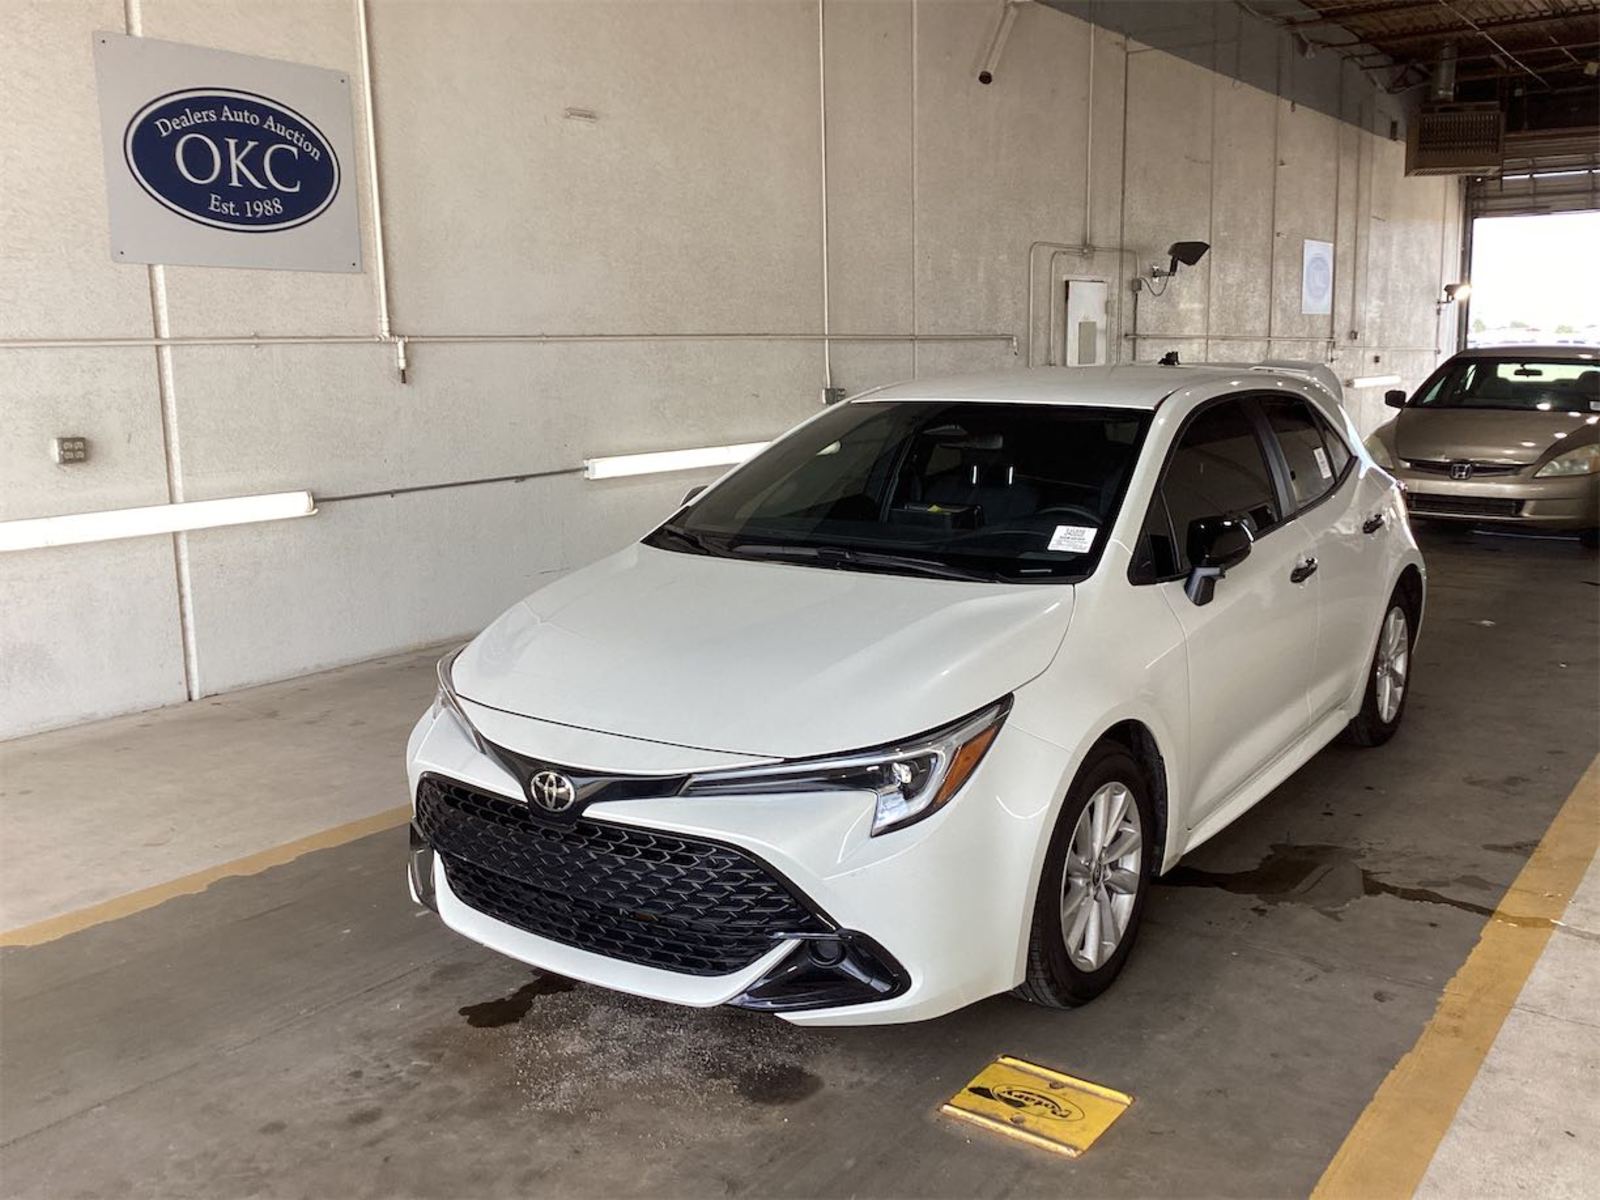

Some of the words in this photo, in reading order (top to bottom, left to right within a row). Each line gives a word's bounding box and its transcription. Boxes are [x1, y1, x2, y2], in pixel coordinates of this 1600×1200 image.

[155, 109, 217, 137] Dealers
[220, 105, 260, 126] Auto
[263, 115, 321, 161] Auction
[174, 132, 301, 193] OKC
[209, 194, 239, 217] Est.
[244, 198, 283, 218] 1988
[1002, 1089, 1072, 1118] Rotary
